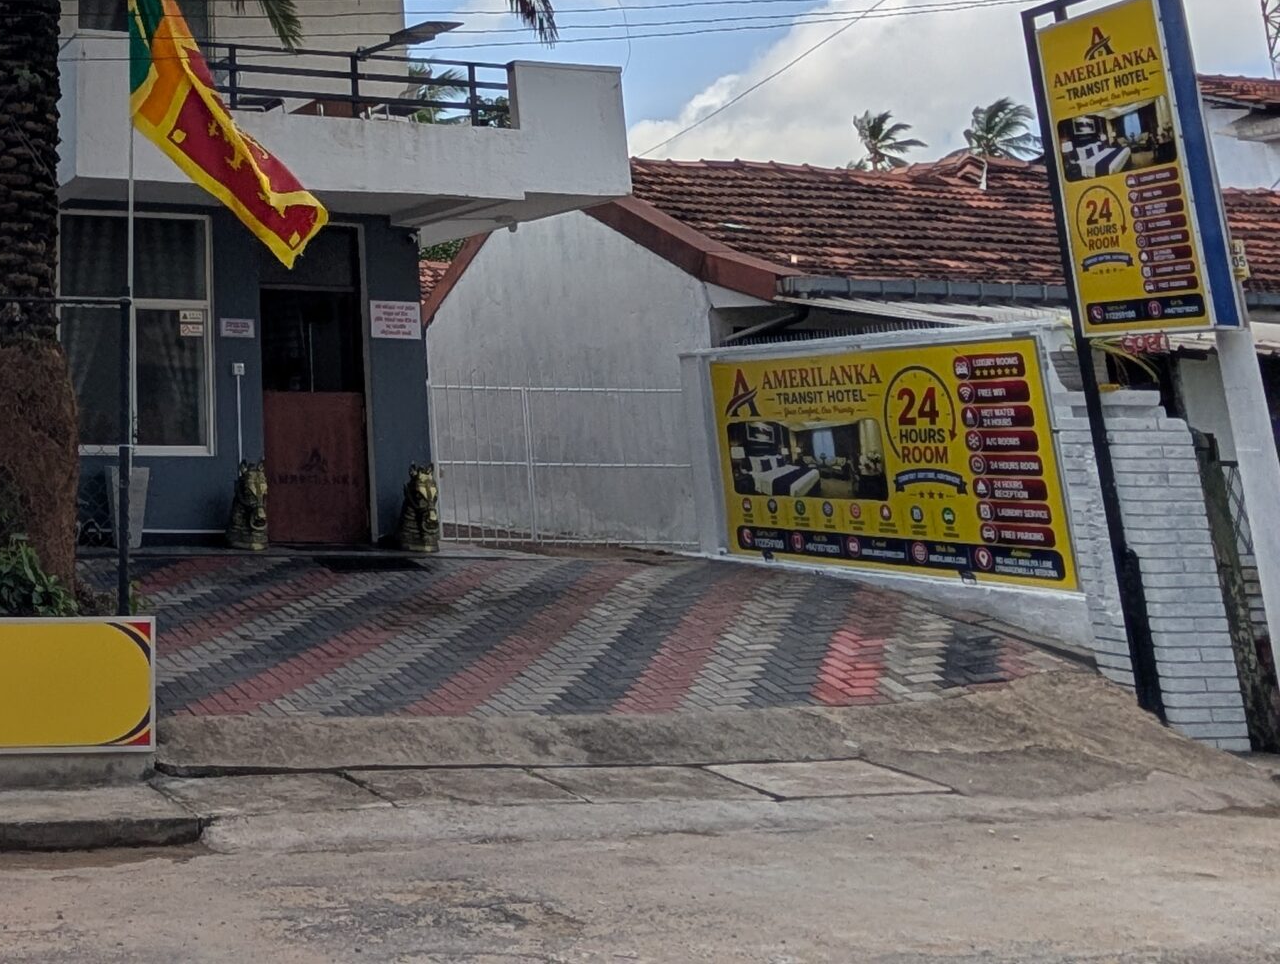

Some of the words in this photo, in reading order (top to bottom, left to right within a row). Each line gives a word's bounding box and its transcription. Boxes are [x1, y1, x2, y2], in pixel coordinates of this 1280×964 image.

[1054, 46, 1158, 88] AMERILANKA
[1066, 78, 1110, 101] TRANSIT
[1114, 69, 1148, 89] HOTEL
[1086, 198, 1112, 225] 24
[1087, 224, 1117, 237] HOURS
[1088, 235, 1120, 251] ROOM
[761, 364, 882, 389] AMERILANKA
[776, 391, 823, 405] TRANSIT
[827, 389, 866, 404] HOTEL
[897, 387, 939, 426] 24
[900, 428, 945, 444] HOURS
[902, 446, 948, 464] ROOM
